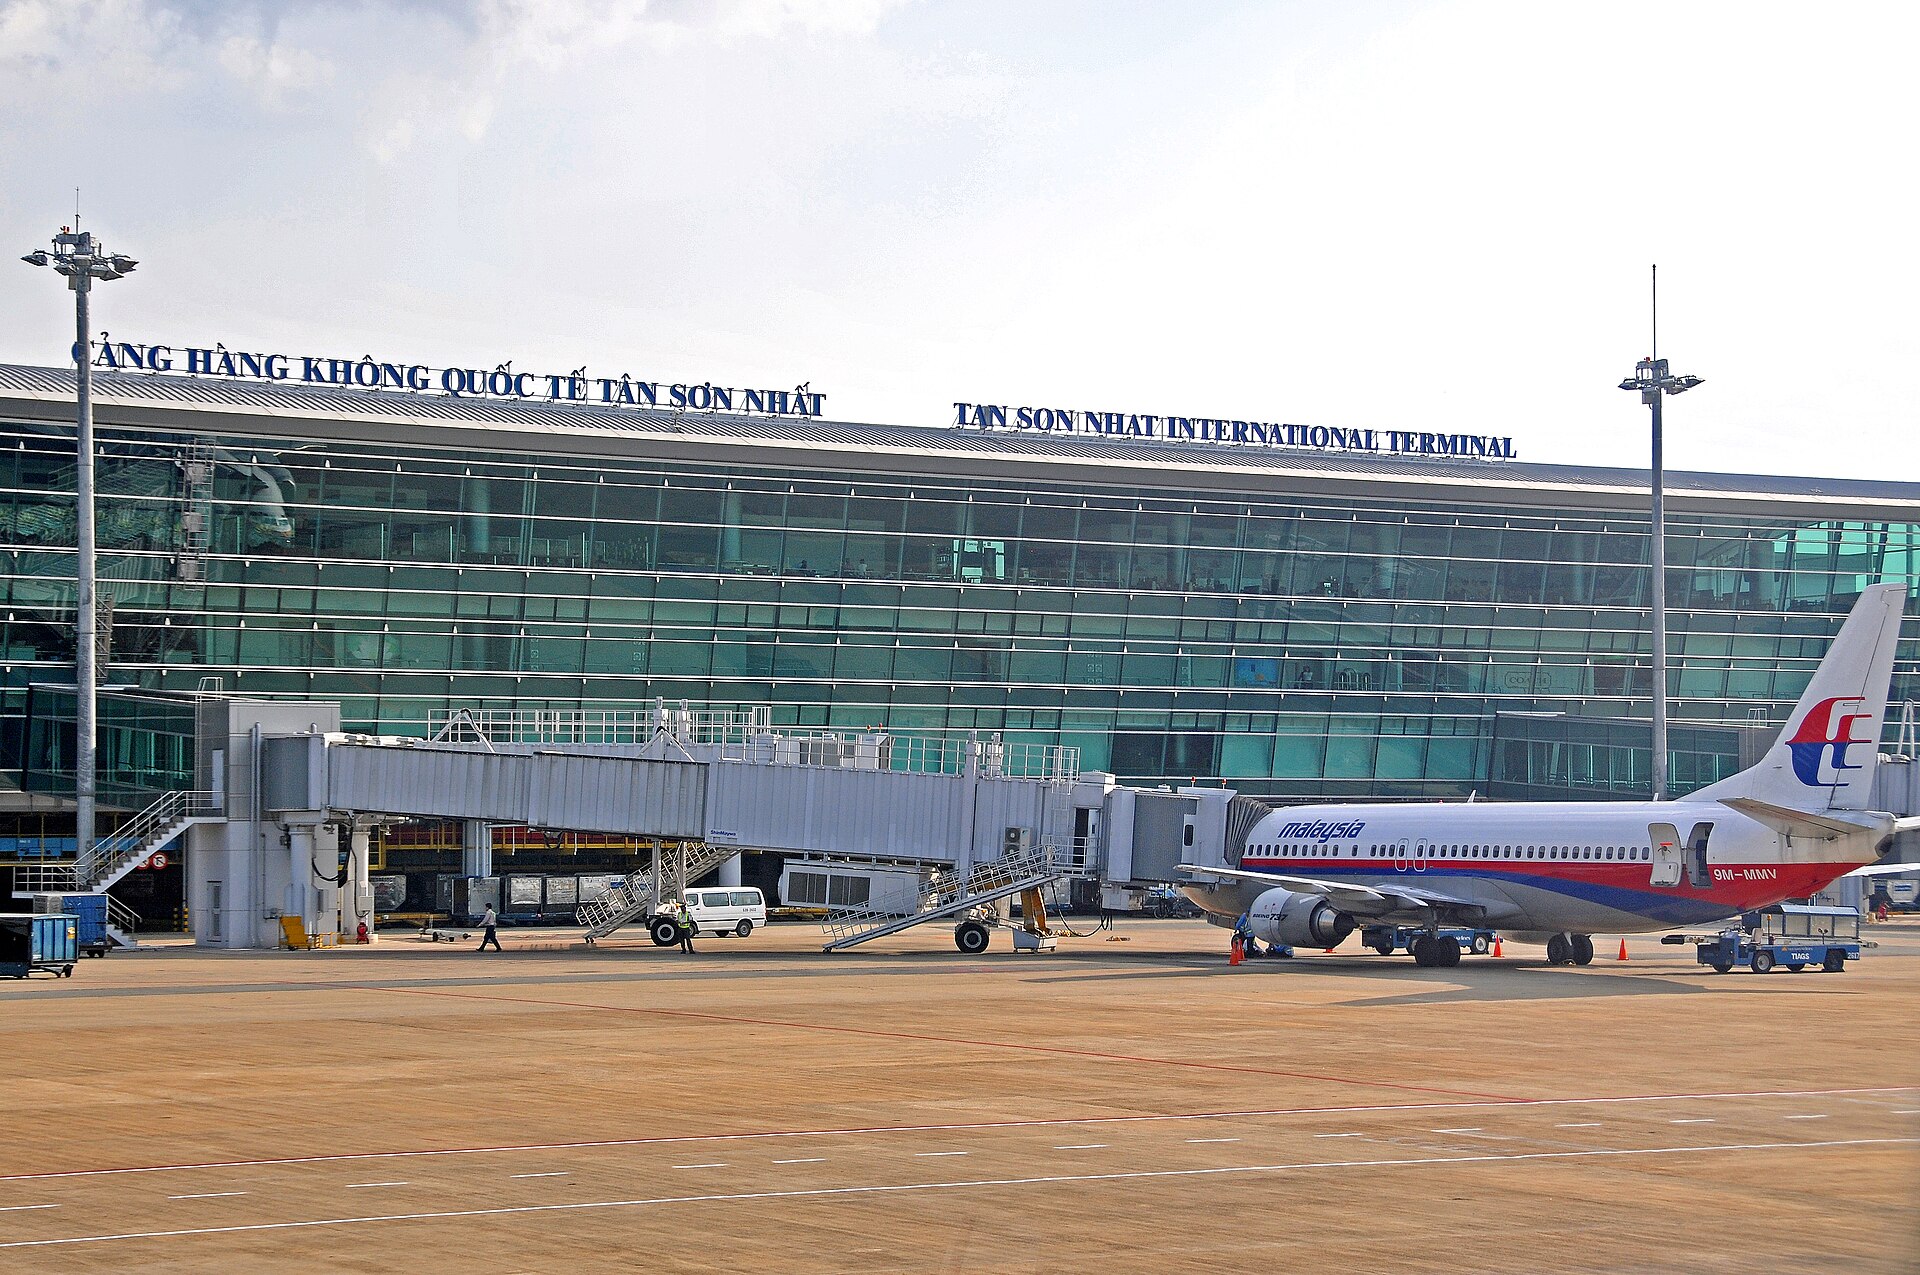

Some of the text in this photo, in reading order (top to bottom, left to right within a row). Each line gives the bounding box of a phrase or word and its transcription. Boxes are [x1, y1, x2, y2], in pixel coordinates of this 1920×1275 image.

[185, 342, 290, 380] HÀNG
[300, 354, 430, 391] KHÔNG
[441, 360, 535, 398] QUỐC
[544, 366, 587, 401] TẾ
[596, 372, 659, 405] TÂN
[669, 381, 734, 411] SƠN
[744, 381, 827, 417] NHẤT
[953, 403, 1517, 459] TAN SON NHAT INTERNATIONAL TERMINAL
[1277, 818, 1366, 843] malaysia
[1713, 868, 1777, 881] 9M-MMV
[1269, 913, 1289, 922] 737
